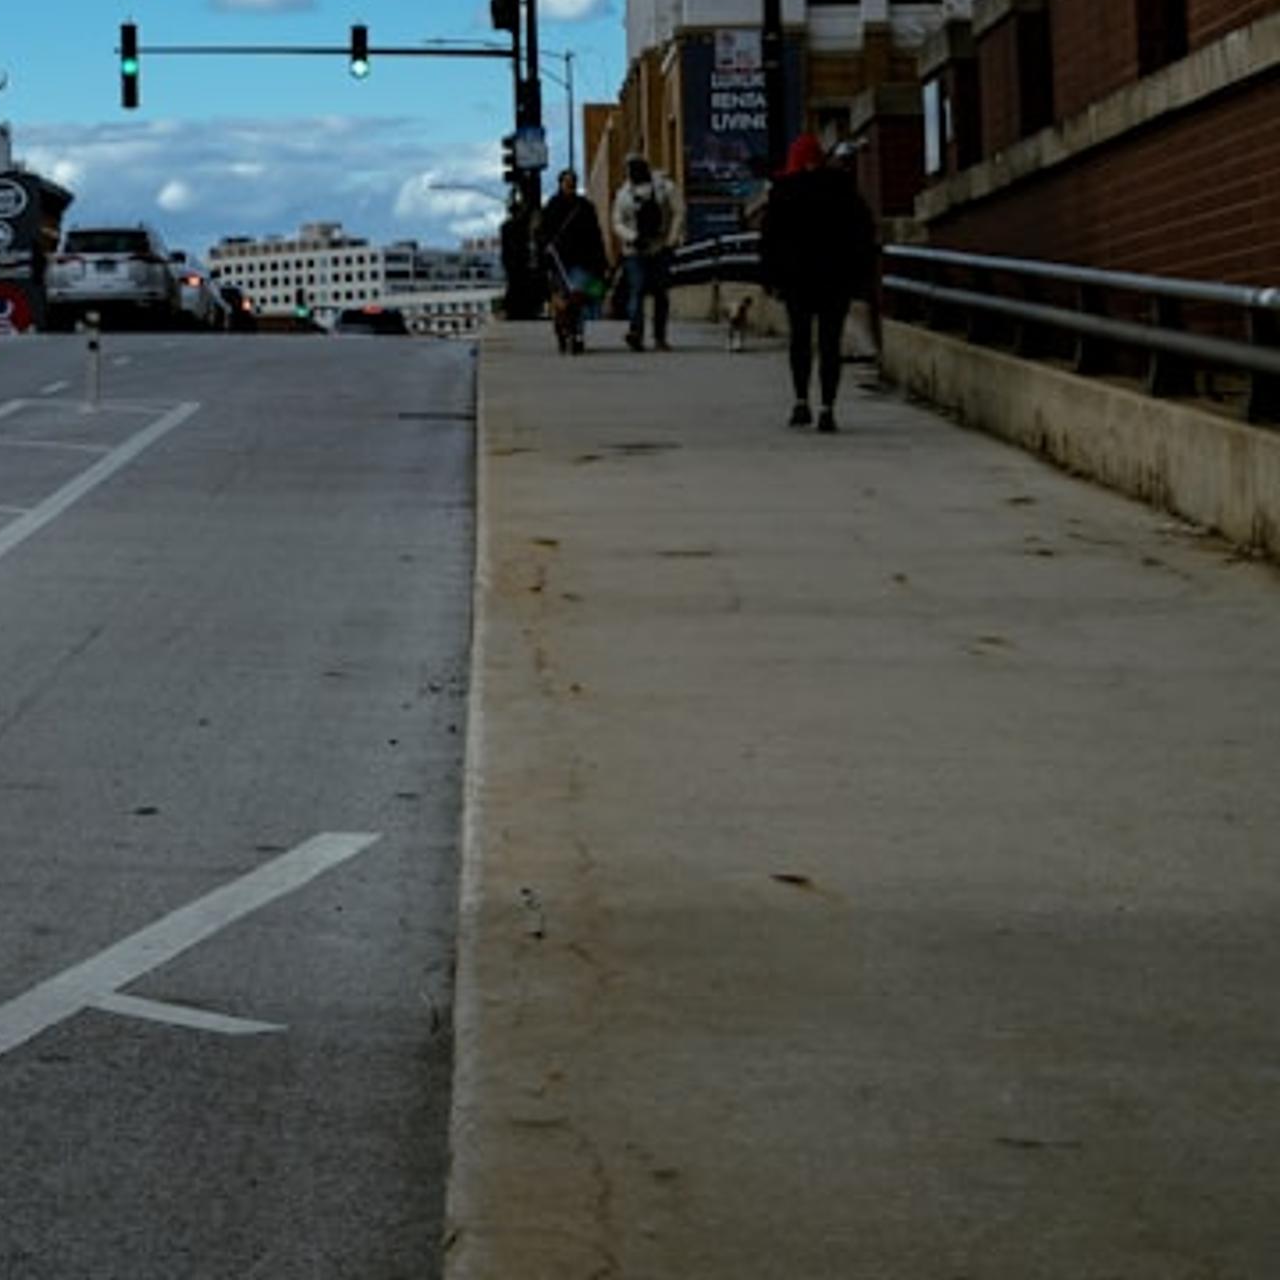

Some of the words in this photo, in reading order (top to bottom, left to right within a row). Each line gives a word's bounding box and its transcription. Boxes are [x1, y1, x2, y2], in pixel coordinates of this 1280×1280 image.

[711, 72, 767, 88] LUXUR
[711, 92, 768, 108] RENTA
[711, 110, 768, 129] LIVIN
